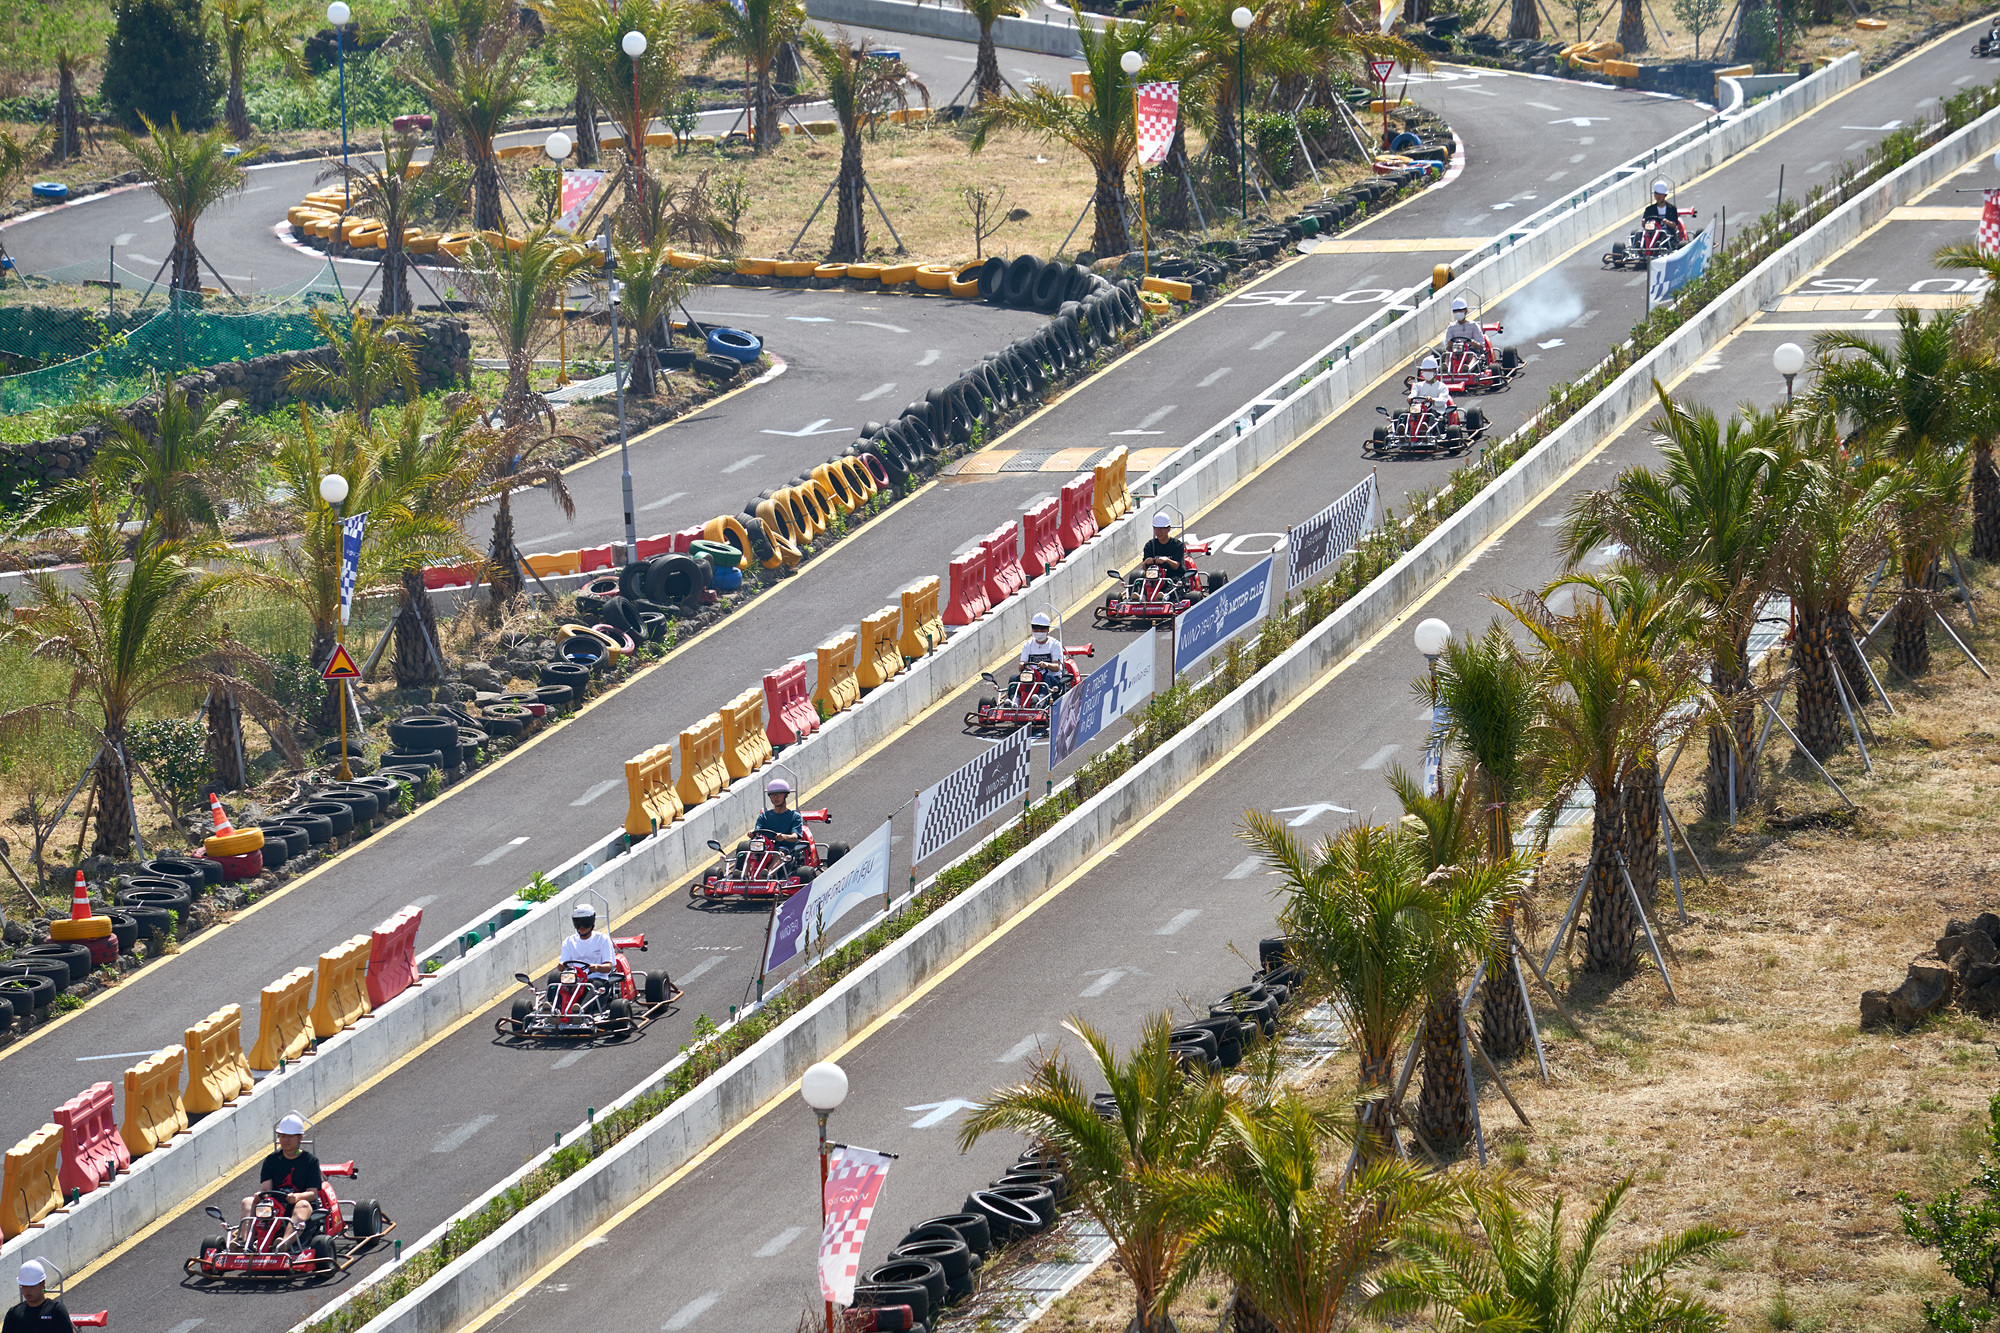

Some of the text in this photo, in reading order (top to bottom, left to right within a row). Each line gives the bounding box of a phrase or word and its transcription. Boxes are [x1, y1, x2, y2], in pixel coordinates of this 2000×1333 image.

[1228, 591, 1248, 615] MOTOR
[1249, 581, 1264, 601] CLUB
[1085, 669, 1109, 698] EXTREME
[1082, 691, 1102, 716] CIRCUIT
